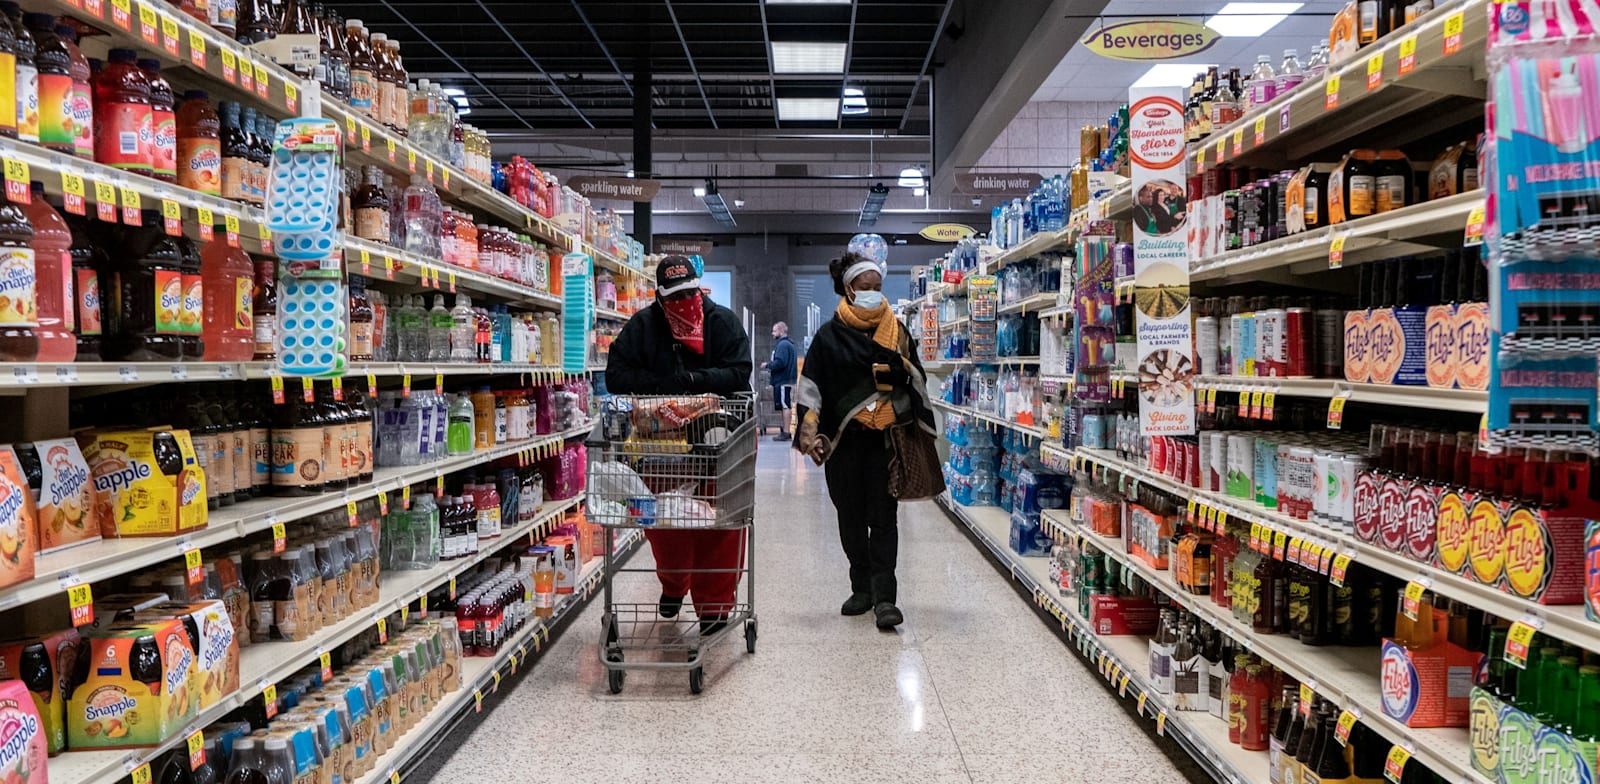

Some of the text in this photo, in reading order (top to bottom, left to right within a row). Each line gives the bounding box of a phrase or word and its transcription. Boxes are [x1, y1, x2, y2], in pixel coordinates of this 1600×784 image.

[113, 6, 128, 20] LOW
[142, 23, 154, 34] LOW
[164, 36, 176, 48] LOW
[1103, 33, 1204, 50] Beverages
[1131, 126, 1182, 139] Hometown
[1140, 138, 1176, 152] Store
[8, 180, 27, 194] LOW
[581, 181, 643, 196] sparkling water
[973, 176, 1030, 190] drinking water
[65, 192, 81, 205] LOW
[98, 202, 113, 214] LOW
[124, 206, 139, 218] LOW
[165, 218, 178, 230] LOW
[200, 224, 212, 236] LOW
[937, 229, 959, 237] Water
[1137, 239, 1185, 250] Building
[8, 268, 26, 280] diet
[1139, 322, 1189, 332] Supporting
[1345, 324, 1370, 362] Fitz's
[1370, 323, 1394, 362] Fitz's
[1428, 320, 1455, 365] Fitz's
[1149, 411, 1186, 424] Giving
[50, 466, 87, 505] Snapple
[1354, 483, 1378, 524] Fitz's
[1380, 491, 1405, 532] Fitz's
[1406, 498, 1435, 540] Fitz's
[1438, 506, 1469, 551] Fitz's
[1470, 514, 1504, 562] Fitz's
[1506, 522, 1544, 574] Fitz's
[189, 568, 200, 578] LOW
[73, 606, 89, 619] LOW
[106, 645, 116, 657] 6
[206, 628, 233, 670] Snapple
[167, 648, 192, 694] Snapple
[1383, 658, 1410, 701] Fitz's
[86, 696, 136, 720] Snapple
[0, 714, 36, 770] napple
[190, 750, 202, 763] LOW
[1500, 726, 1537, 778] Fitz's
